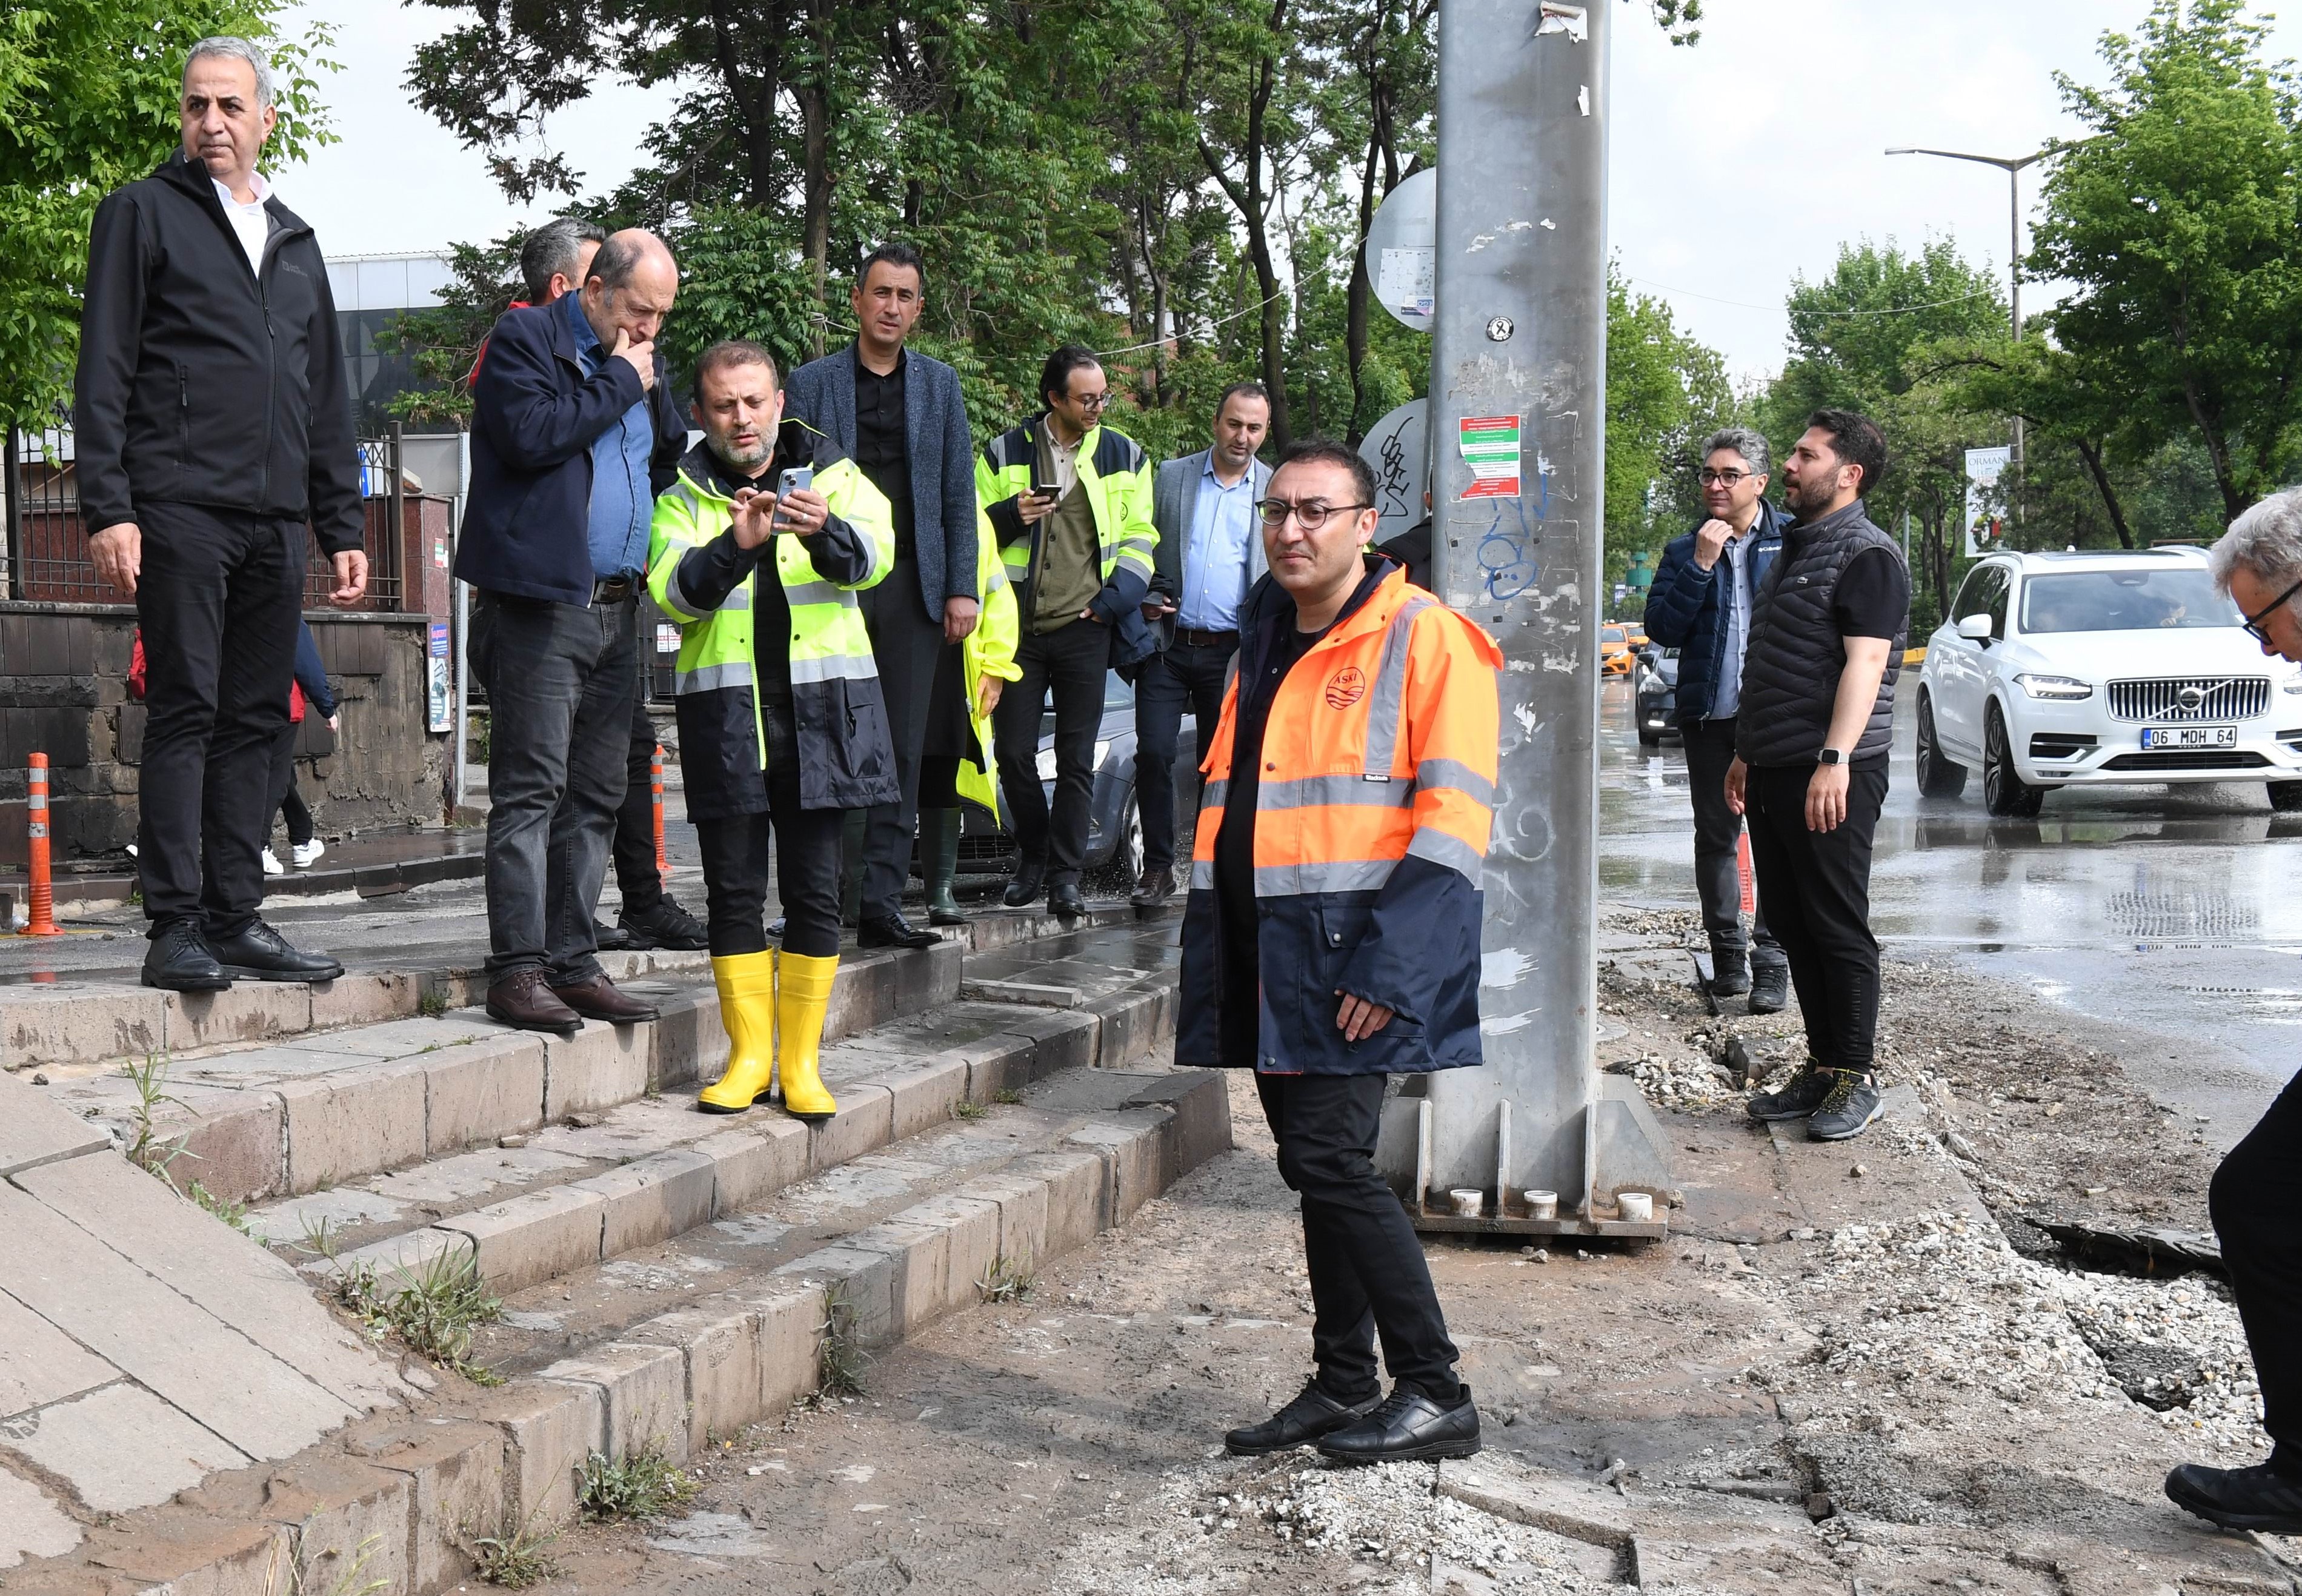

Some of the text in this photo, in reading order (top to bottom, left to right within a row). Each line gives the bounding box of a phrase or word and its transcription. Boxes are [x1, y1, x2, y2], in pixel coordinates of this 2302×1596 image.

[1969, 456, 2006, 466] ORMAN
[1334, 671, 1357, 684] ASKİ
[2152, 729, 2234, 744] 06 MDH 64
